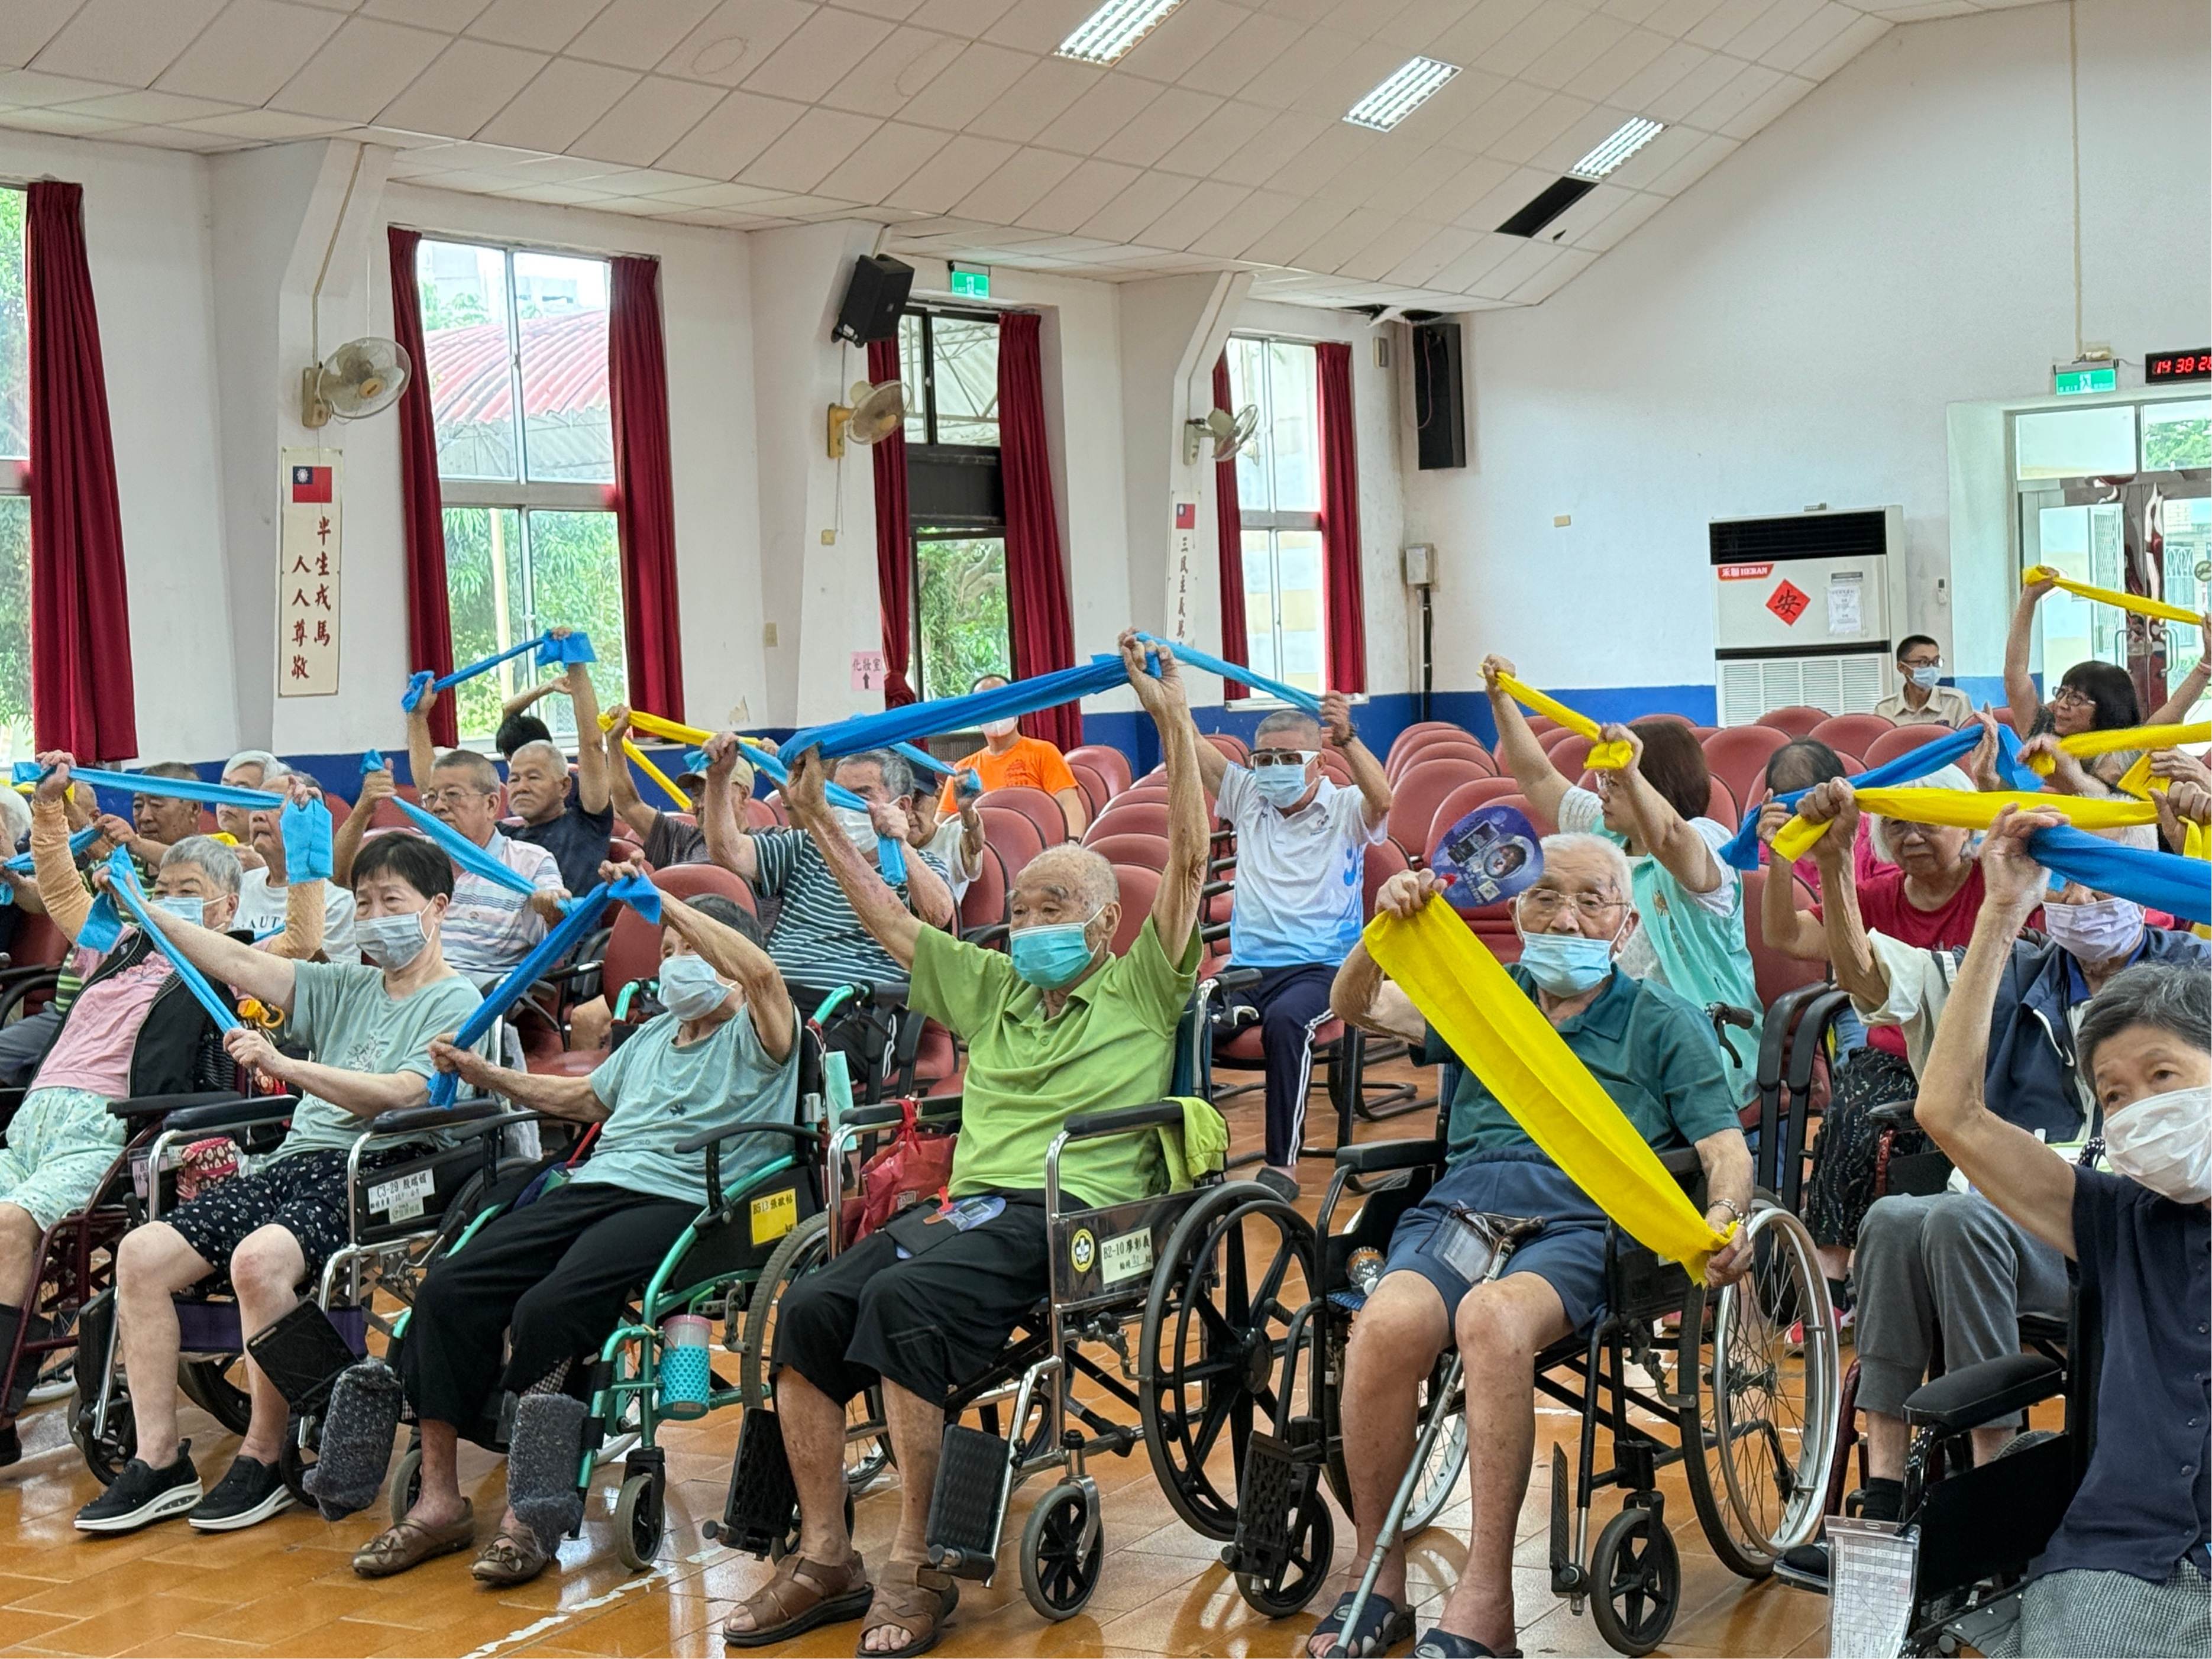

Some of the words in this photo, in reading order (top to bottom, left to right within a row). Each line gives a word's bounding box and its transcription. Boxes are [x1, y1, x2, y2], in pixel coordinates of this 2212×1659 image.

[314, 515, 332, 647] 半生戎馬
[1176, 536, 1189, 646] 三民主義萬
[1774, 588, 1801, 616] 安
[292, 554, 312, 680] 人人尊敬
[377, 1181, 399, 1198] C3-29
[1104, 1241, 1124, 1260] B2-10
